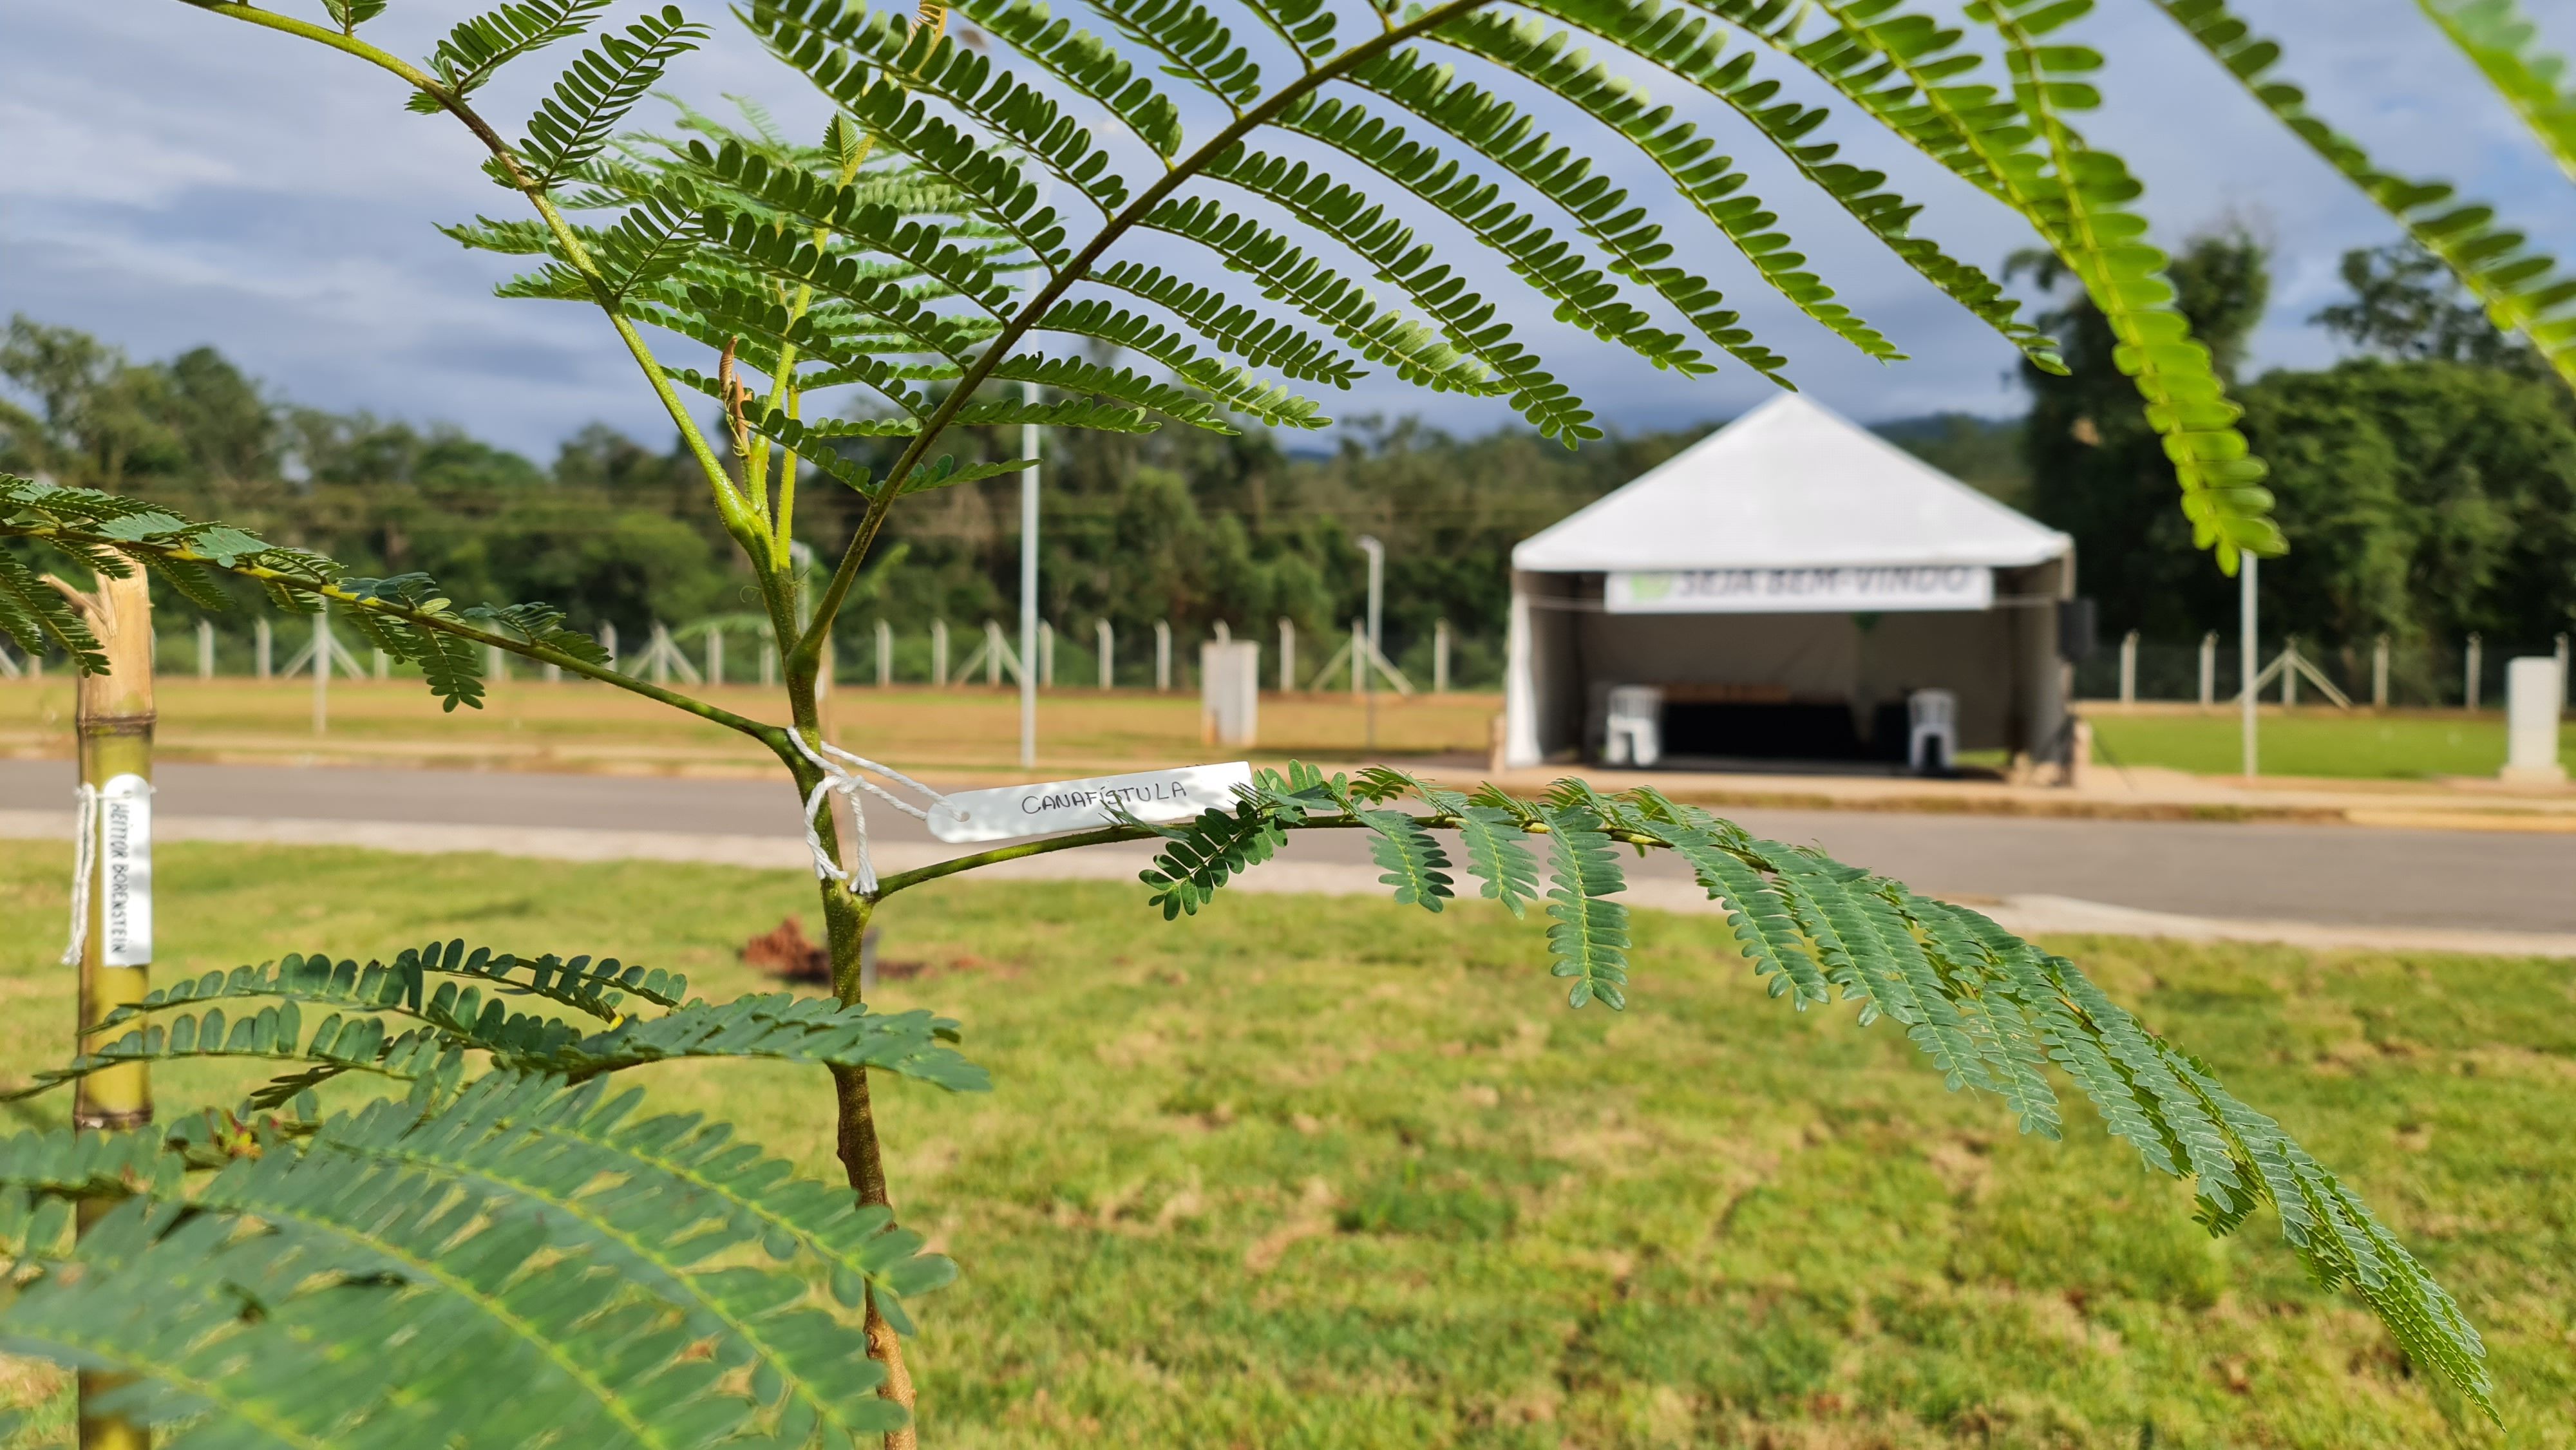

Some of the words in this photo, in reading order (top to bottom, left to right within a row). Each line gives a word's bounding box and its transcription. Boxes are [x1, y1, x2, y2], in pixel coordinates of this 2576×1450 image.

[1678, 569, 1754, 596] SEJA
[1022, 781, 1187, 814] CANAFÍSTULA
[111, 864, 129, 954] BORENSTEIN
